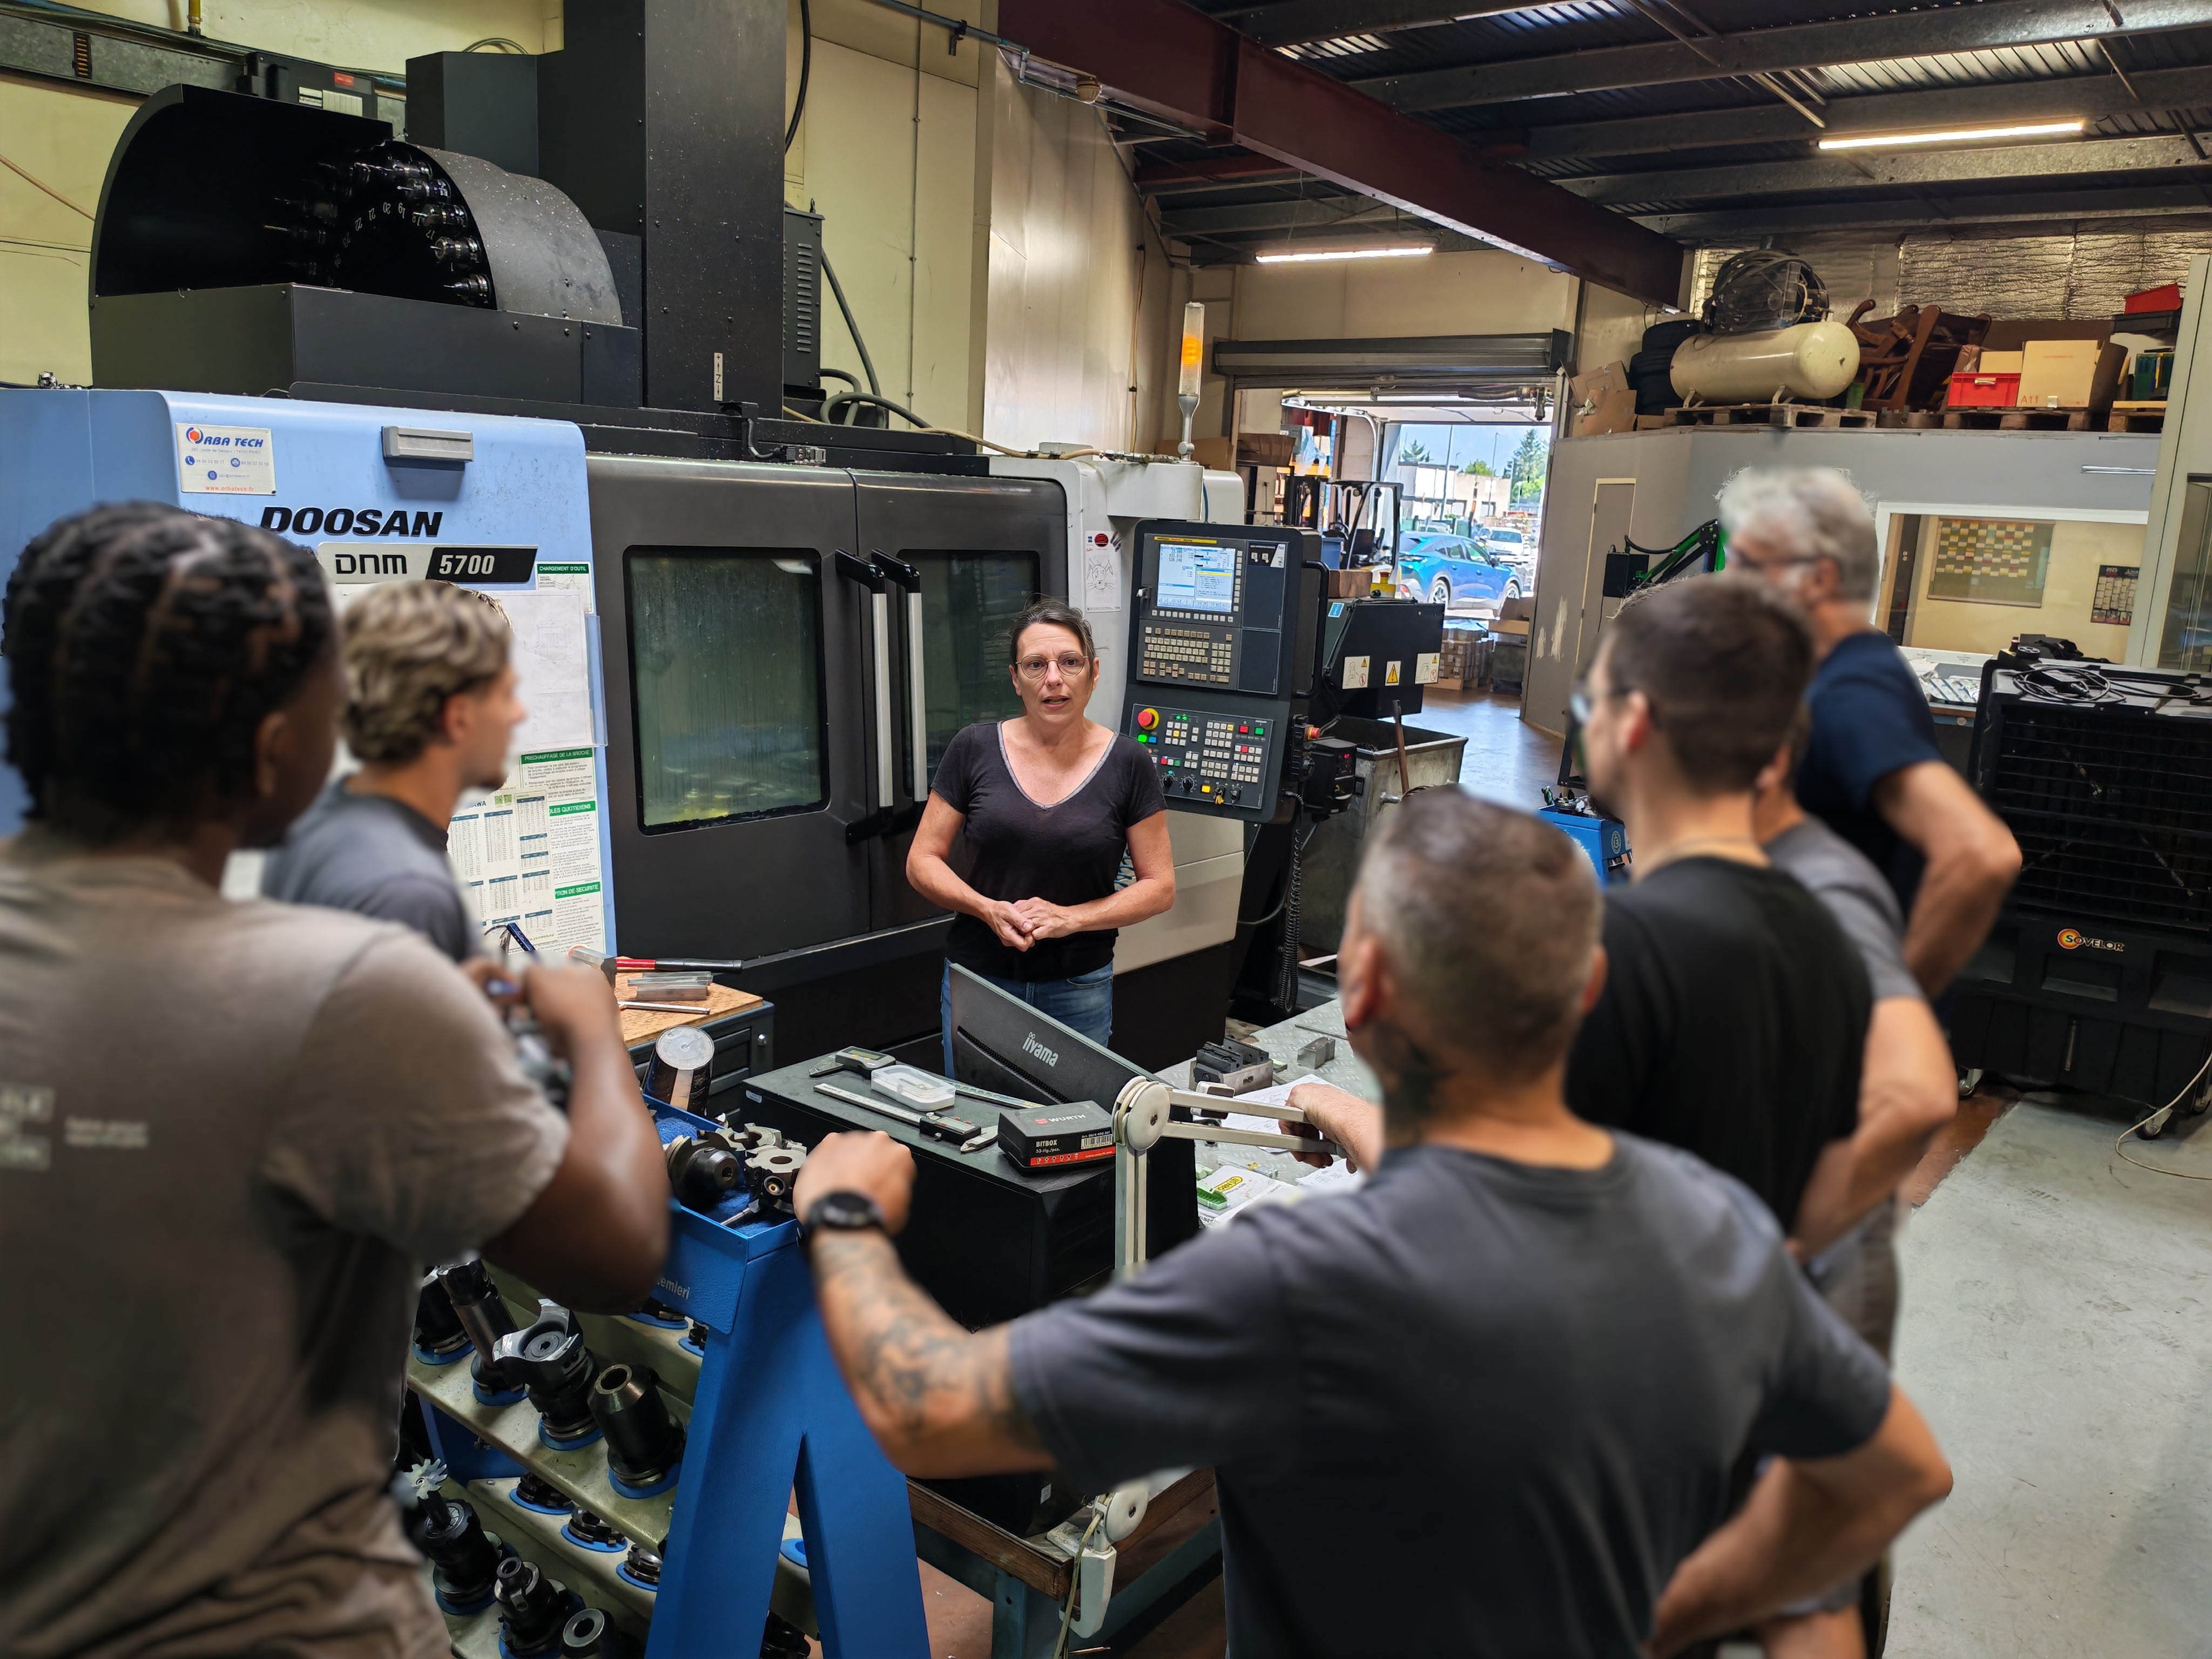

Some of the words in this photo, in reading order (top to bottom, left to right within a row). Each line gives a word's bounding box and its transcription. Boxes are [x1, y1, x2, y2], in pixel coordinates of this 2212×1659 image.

[383, 202, 391, 214] 20
[368, 208, 376, 221] 21
[716, 374, 721, 383] Z
[2021, 395, 2039, 403] A11
[235, 438, 264, 448] TECH
[260, 506, 443, 537] DOOSAN
[439, 555, 495, 575] 5700
[562, 804, 591, 812] QUOTIDIENS
[2065, 935, 2125, 952] SOVELOR
[1022, 1032, 1058, 1067] iiyama
[1036, 1139, 1057, 1148] BITBOX
[657, 1277, 690, 1300] emleri
